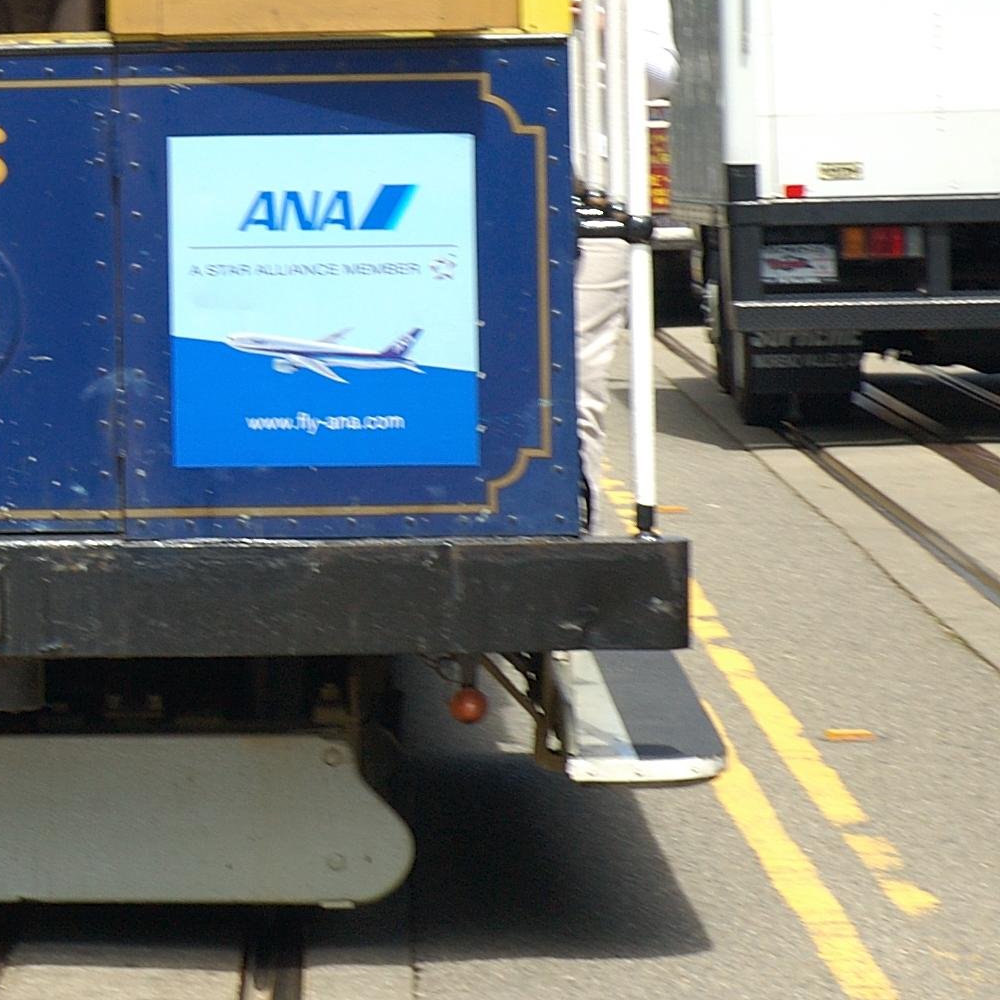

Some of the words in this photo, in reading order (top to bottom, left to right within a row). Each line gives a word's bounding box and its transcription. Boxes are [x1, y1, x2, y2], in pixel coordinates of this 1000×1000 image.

[238, 190, 355, 231] ANA
[189, 265, 202, 277] A
[206, 264, 251, 277] STAR
[255, 263, 339, 277] ALLIANCE
[343, 261, 421, 276] MEMBER
[245, 412, 406, 435] www.fly-ana.com
